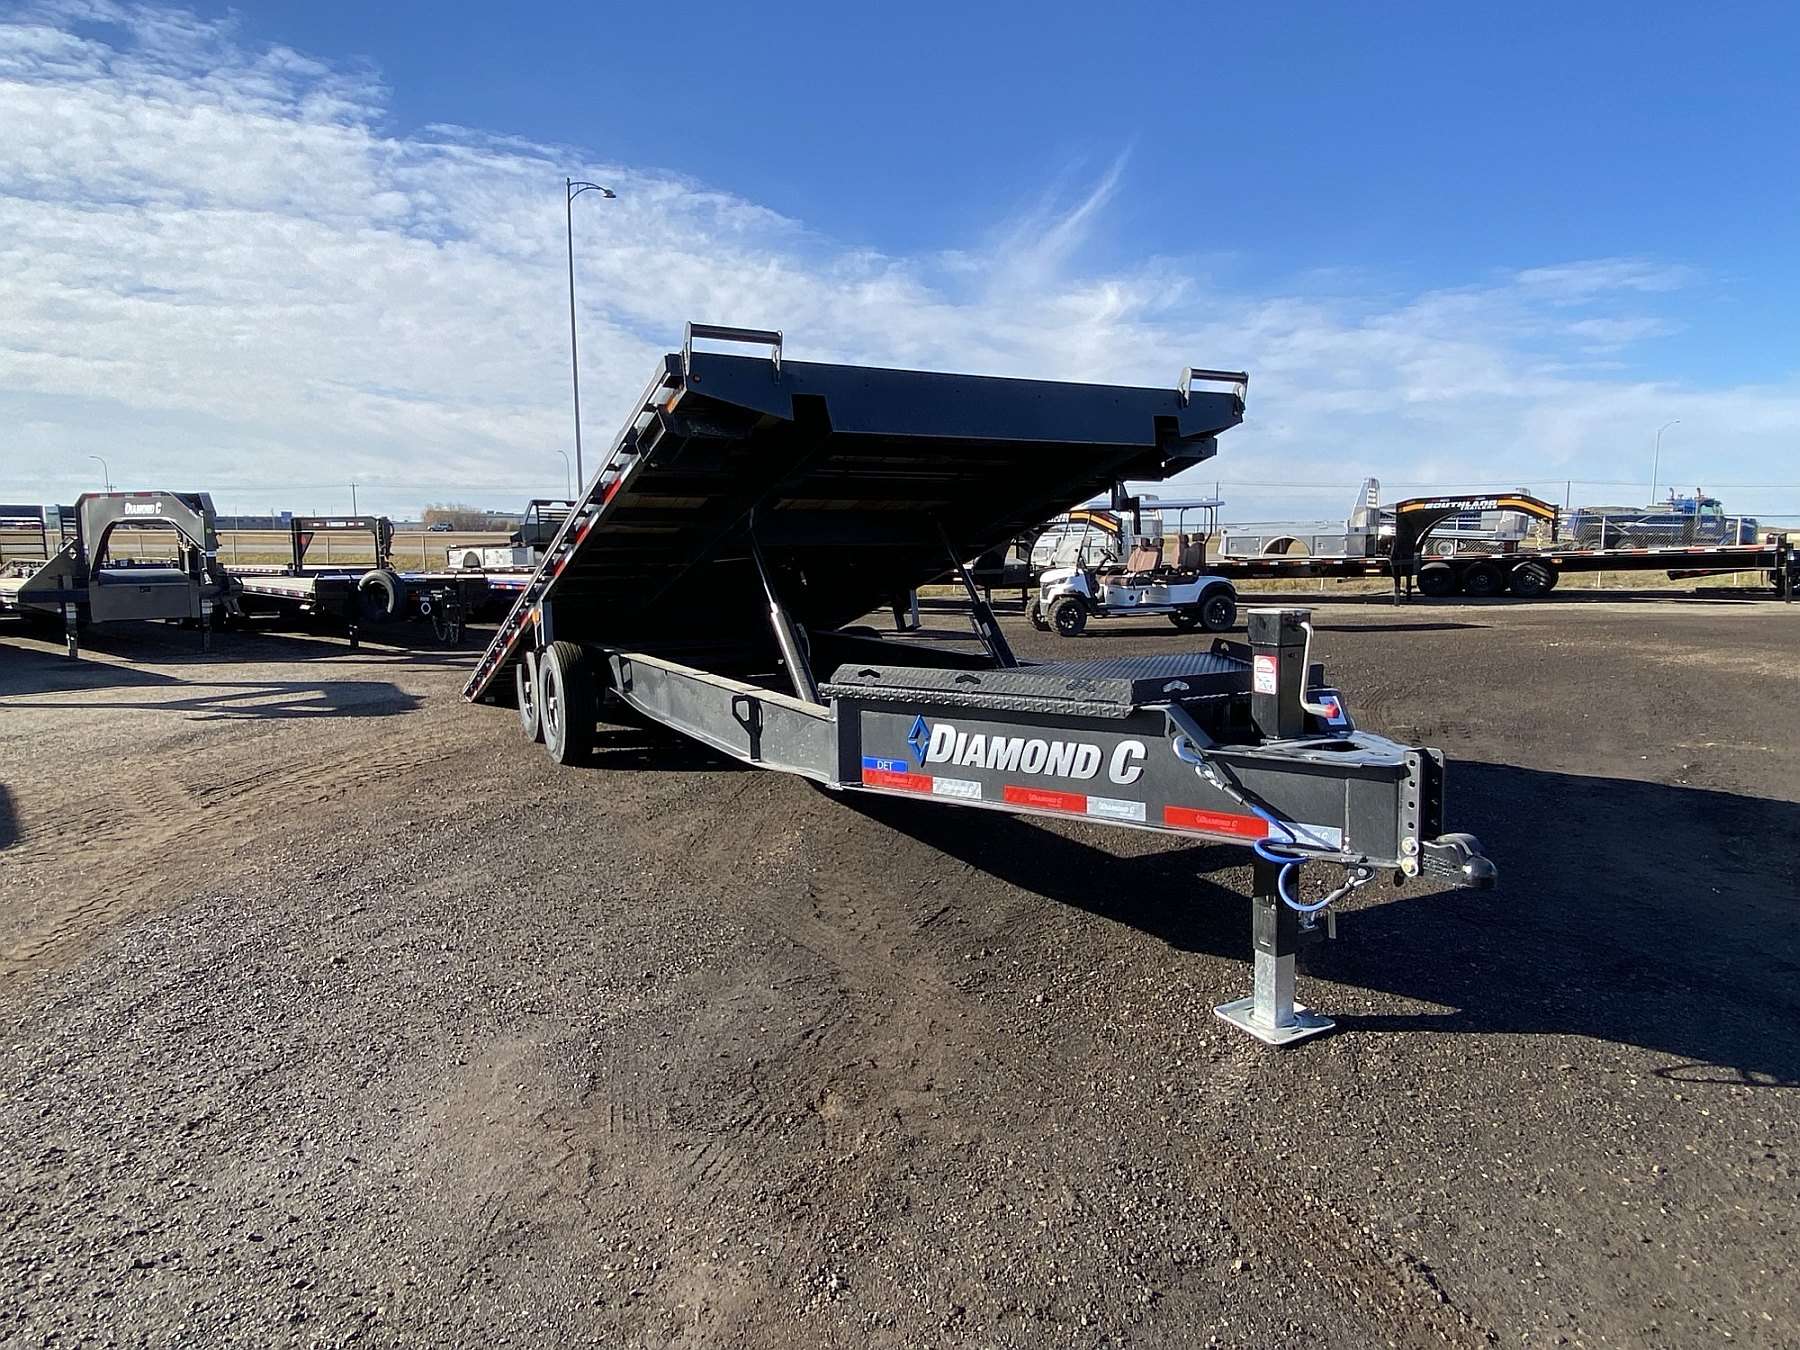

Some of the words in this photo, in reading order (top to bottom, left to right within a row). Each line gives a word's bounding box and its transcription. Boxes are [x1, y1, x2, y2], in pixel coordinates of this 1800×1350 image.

[155, 501, 162, 514] C
[1424, 500, 1498, 509] SOUTHLAND
[926, 723, 1103, 780] DIAMOND
[1108, 739, 1148, 786] C
[877, 760, 893, 771] DET
